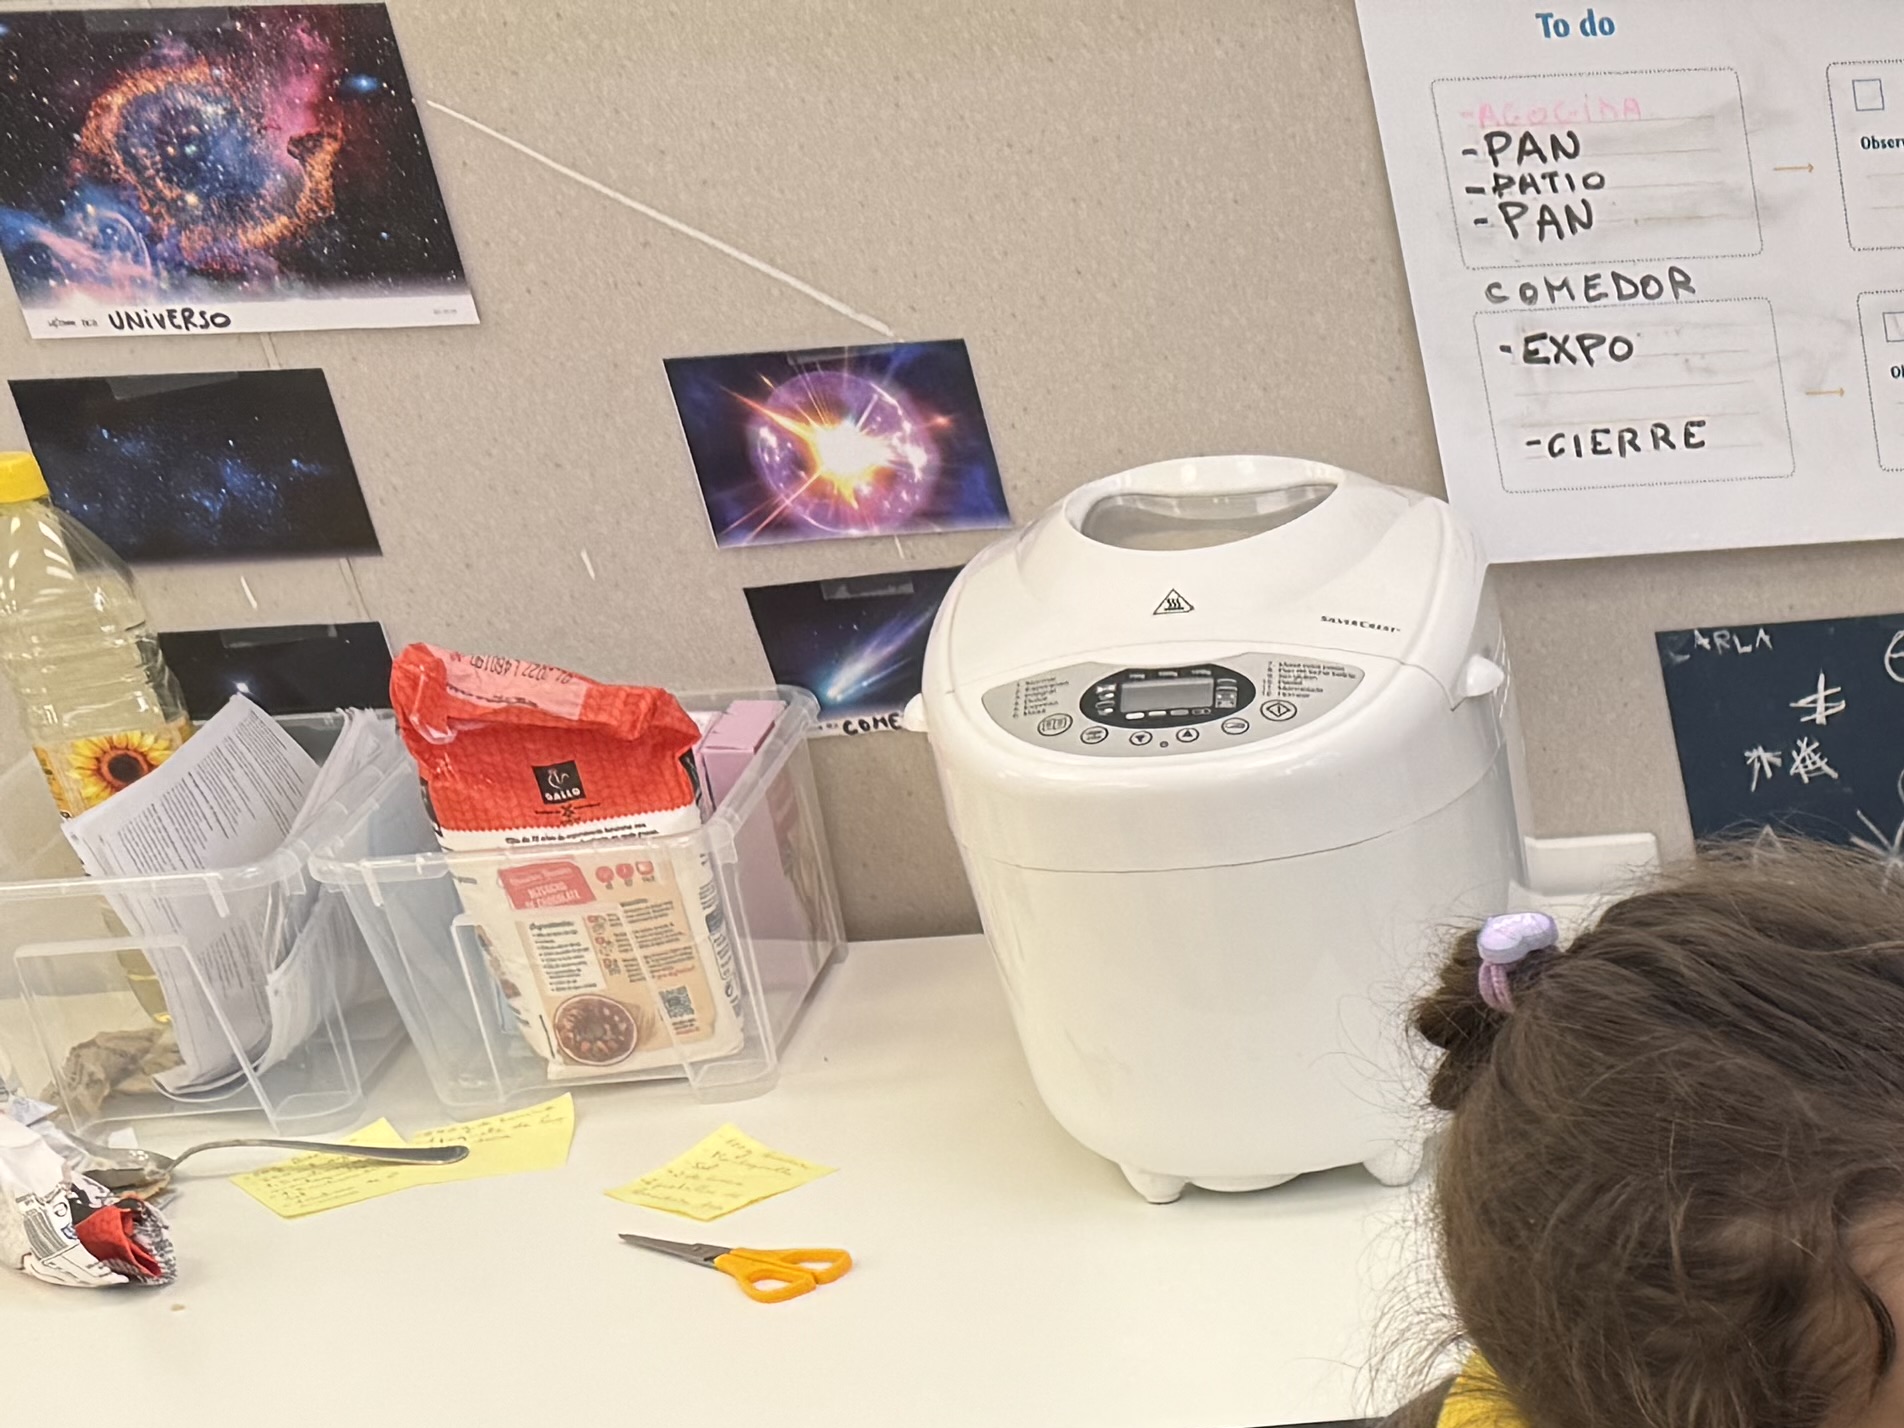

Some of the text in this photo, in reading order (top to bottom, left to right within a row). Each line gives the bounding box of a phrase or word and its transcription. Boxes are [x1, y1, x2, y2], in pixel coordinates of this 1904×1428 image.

[1535, 8, 1615, 38] To do
[1485, 266, 1696, 306] COMEDOR
[545, 788, 581, 801] GALLO
